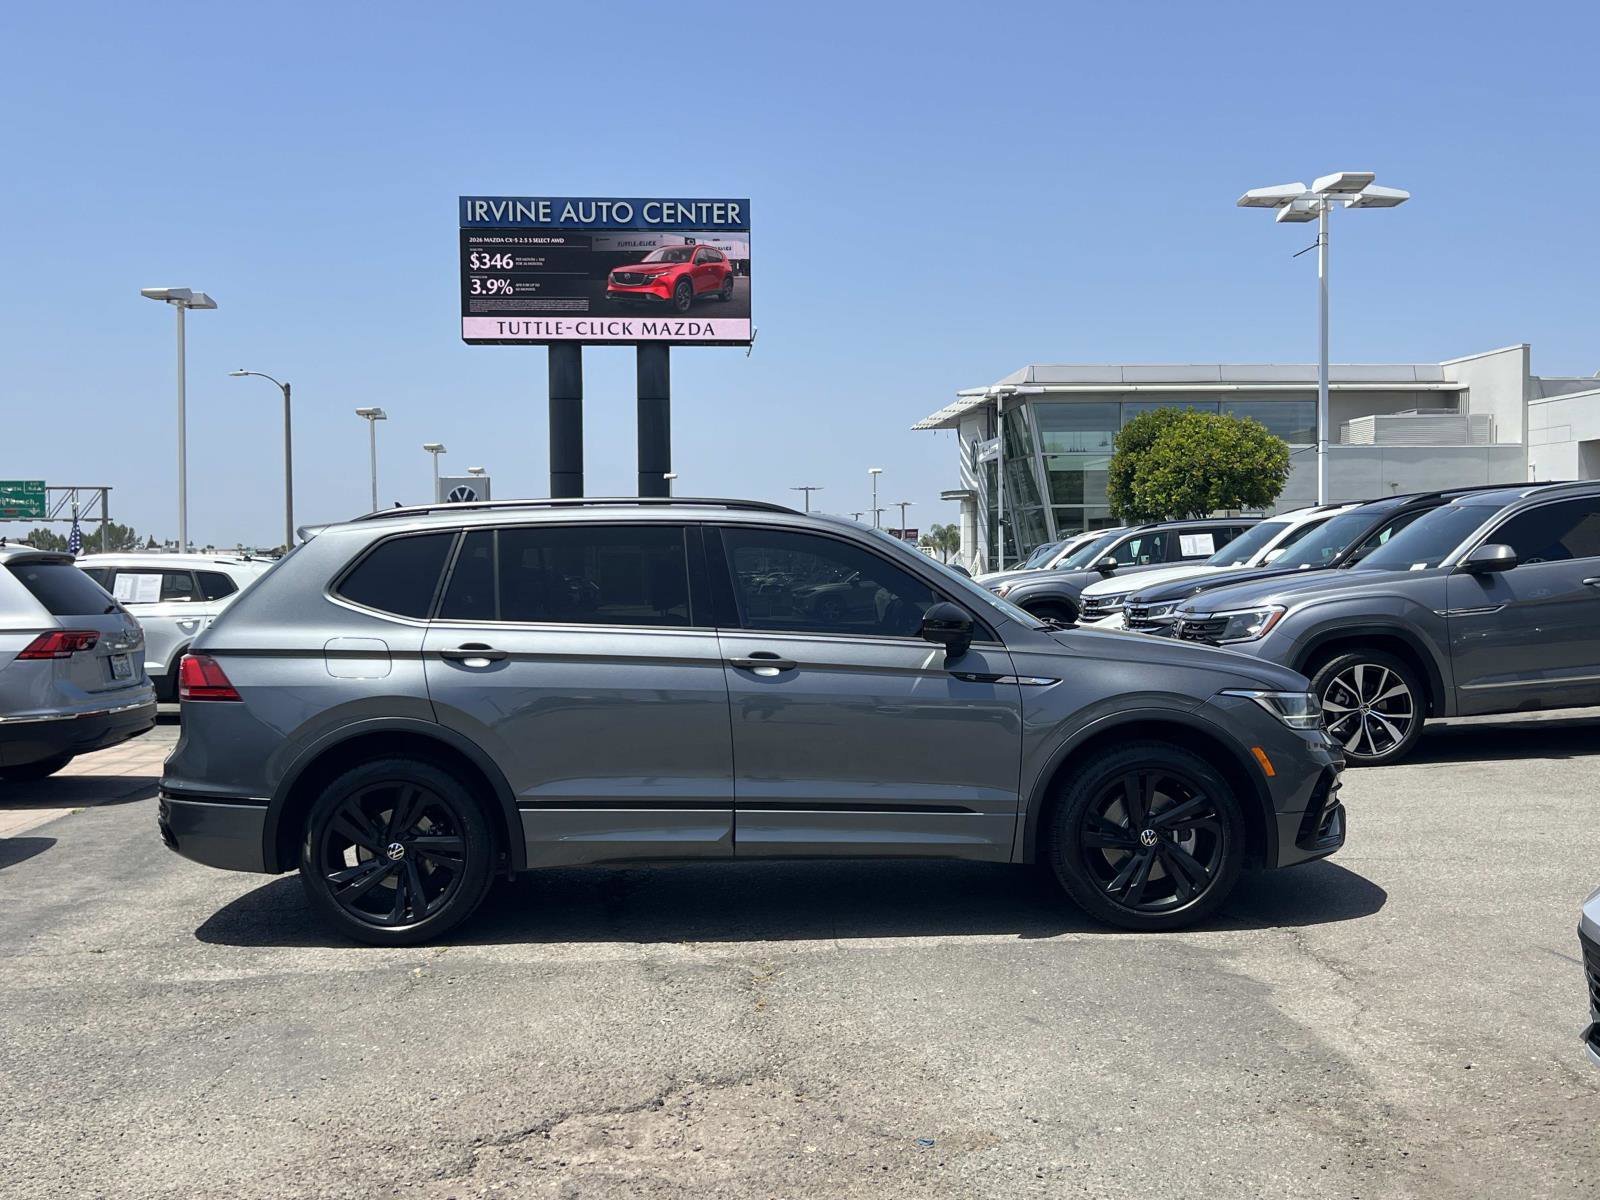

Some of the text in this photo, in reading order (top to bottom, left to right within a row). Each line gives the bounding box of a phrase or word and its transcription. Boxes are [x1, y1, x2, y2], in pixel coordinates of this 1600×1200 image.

[467, 200, 742, 224] IRVINE AUTO CENTER
[469, 252, 514, 270] $346
[470, 279, 513, 295] 3.9%
[497, 321, 716, 336] TUTTLE-CLICK MAZDA
